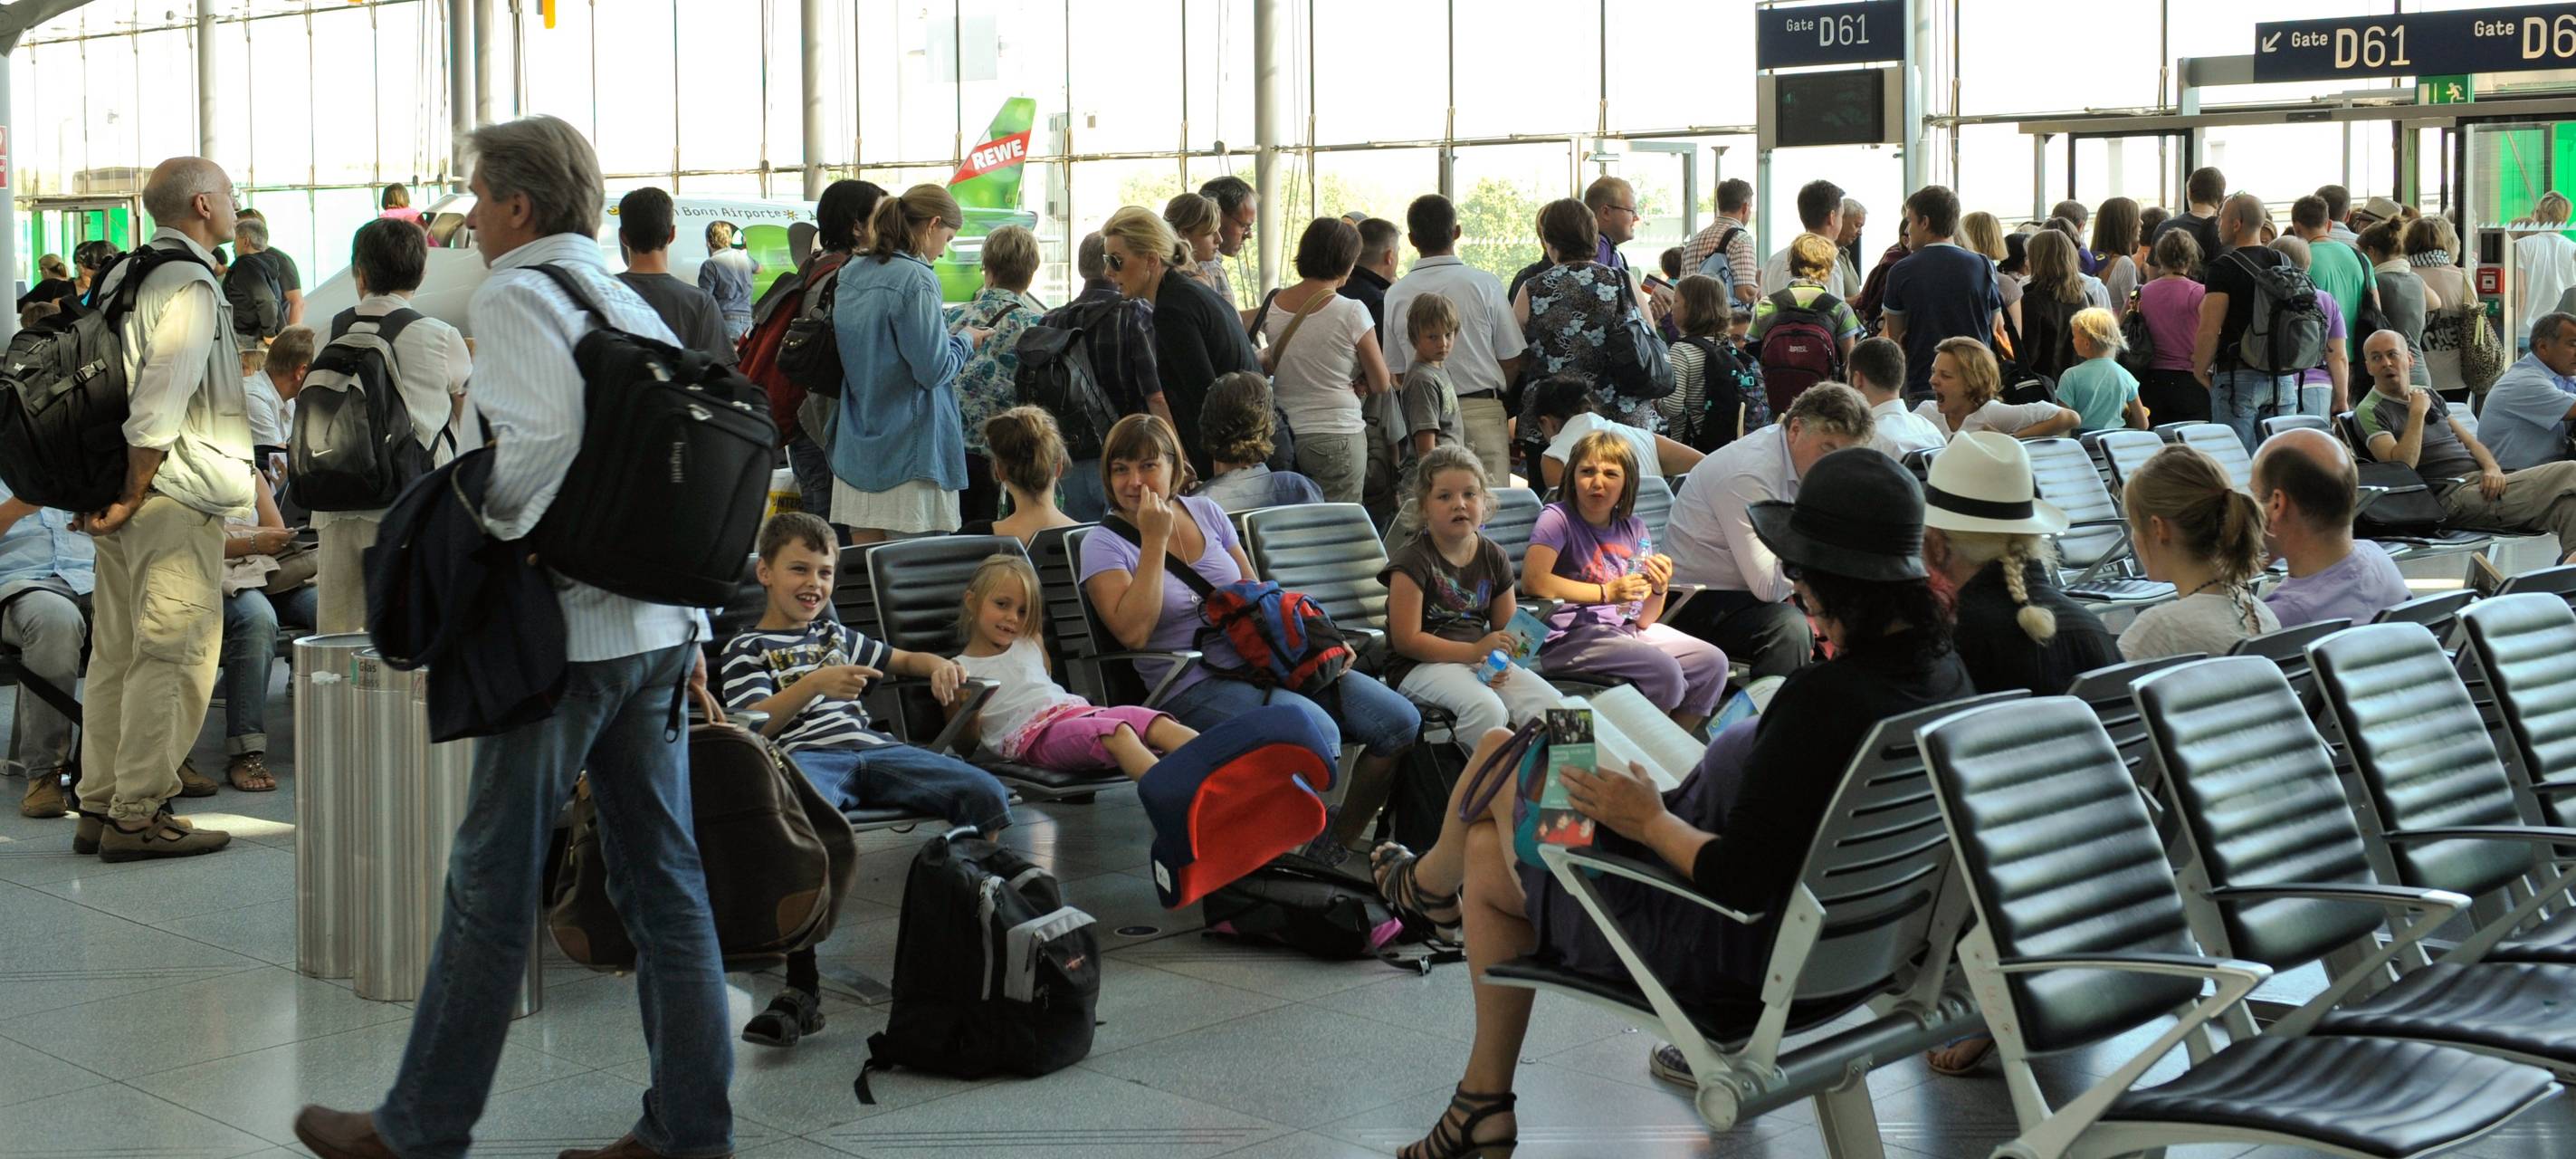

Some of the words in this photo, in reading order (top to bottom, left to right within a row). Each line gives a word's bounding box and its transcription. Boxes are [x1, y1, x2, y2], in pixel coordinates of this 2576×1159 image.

[1786, 18, 1814, 32] Gate
[1819, 14, 1870, 46] D61
[2474, 20, 2515, 37] Gate
[2292, 31, 2329, 48] Gate
[2334, 24, 2411, 70] D61
[971, 139, 1025, 170] REWE
[682, 206, 719, 217] Bonn
[669, 441, 686, 484] bugatti
[359, 661, 377, 673] Glas
